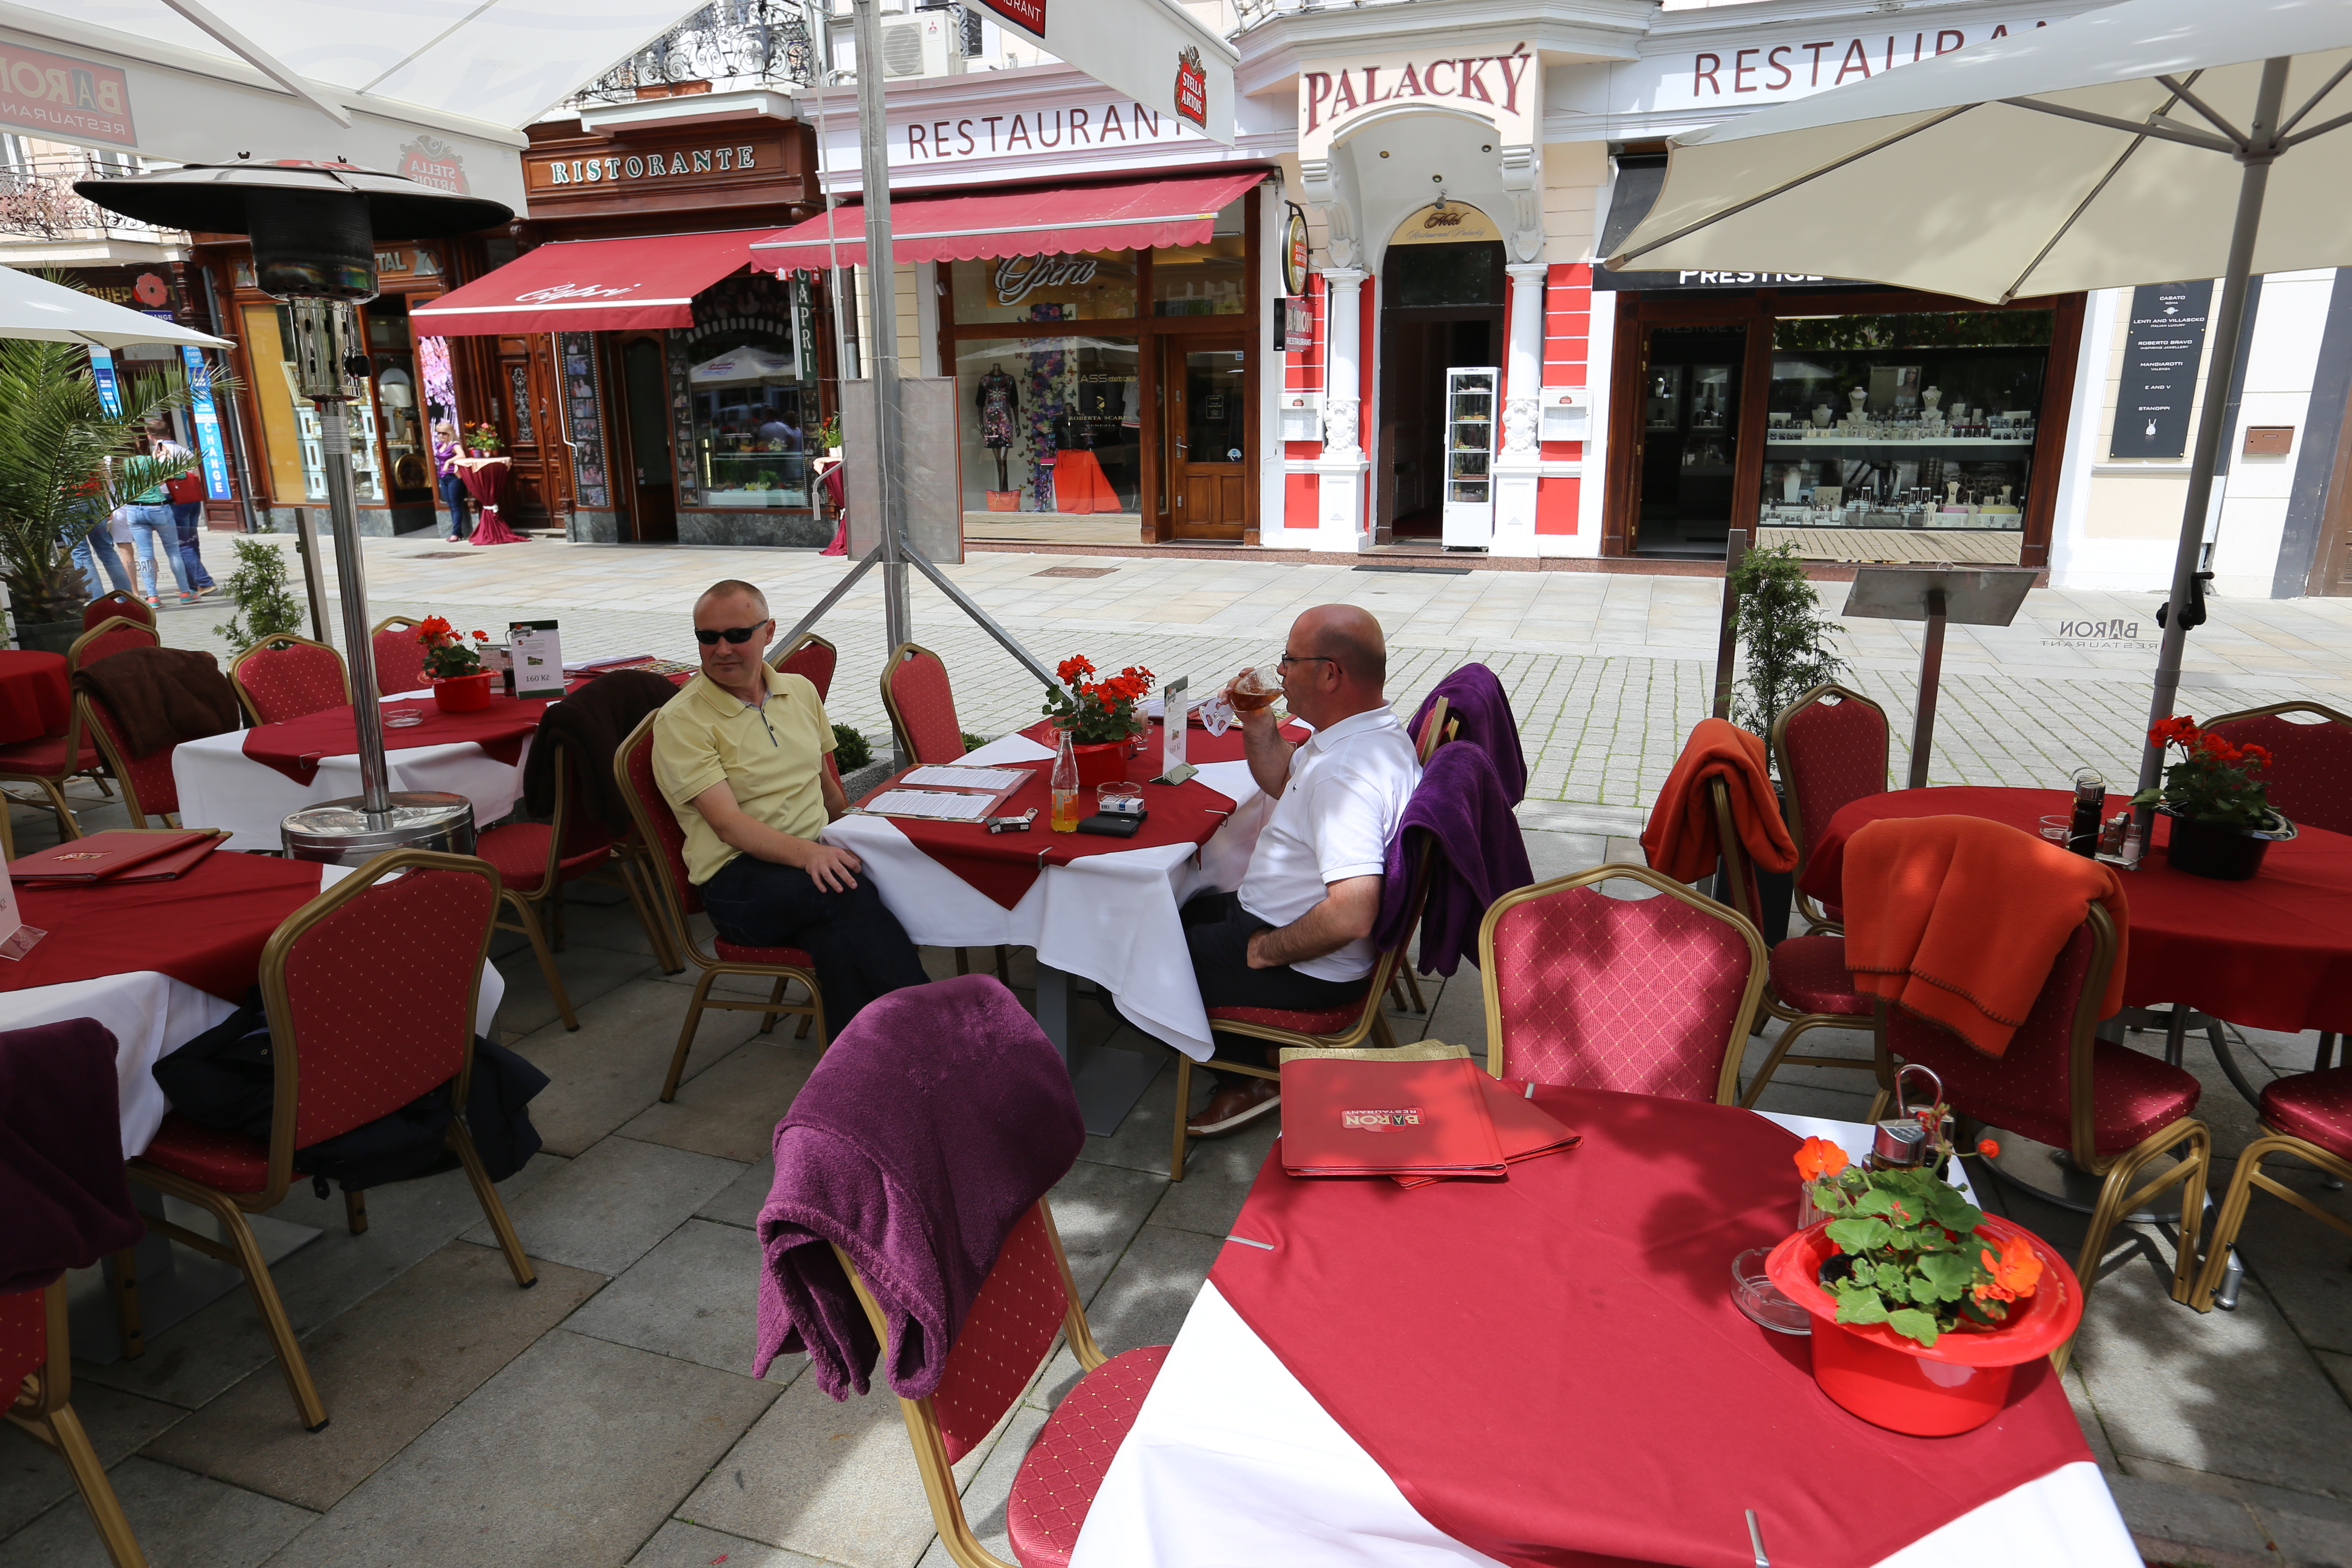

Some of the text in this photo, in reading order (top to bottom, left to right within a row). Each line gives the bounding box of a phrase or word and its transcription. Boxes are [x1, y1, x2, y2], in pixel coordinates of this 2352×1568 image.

[1003, 0, 1041, 22] RANT
[1693, 21, 2047, 97] RESTAUR
[1182, 71, 1202, 98] STELLA
[1304, 41, 1531, 138] PALACKÝ
[1181, 89, 1202, 115] ARTOIS
[551, 146, 754, 184] RISTORANTE
[1424, 213, 1470, 229] Hotel
[1406, 229, 1452, 241] Restaurant
[995, 252, 1097, 306] Opera
[797, 266, 813, 373] CAPRI
[1286, 306, 1313, 334] BARON
[1286, 337, 1312, 346] RESTAURANT
[204, 423, 224, 493] CHANGE
[1346, 1114, 1420, 1125] BARON
